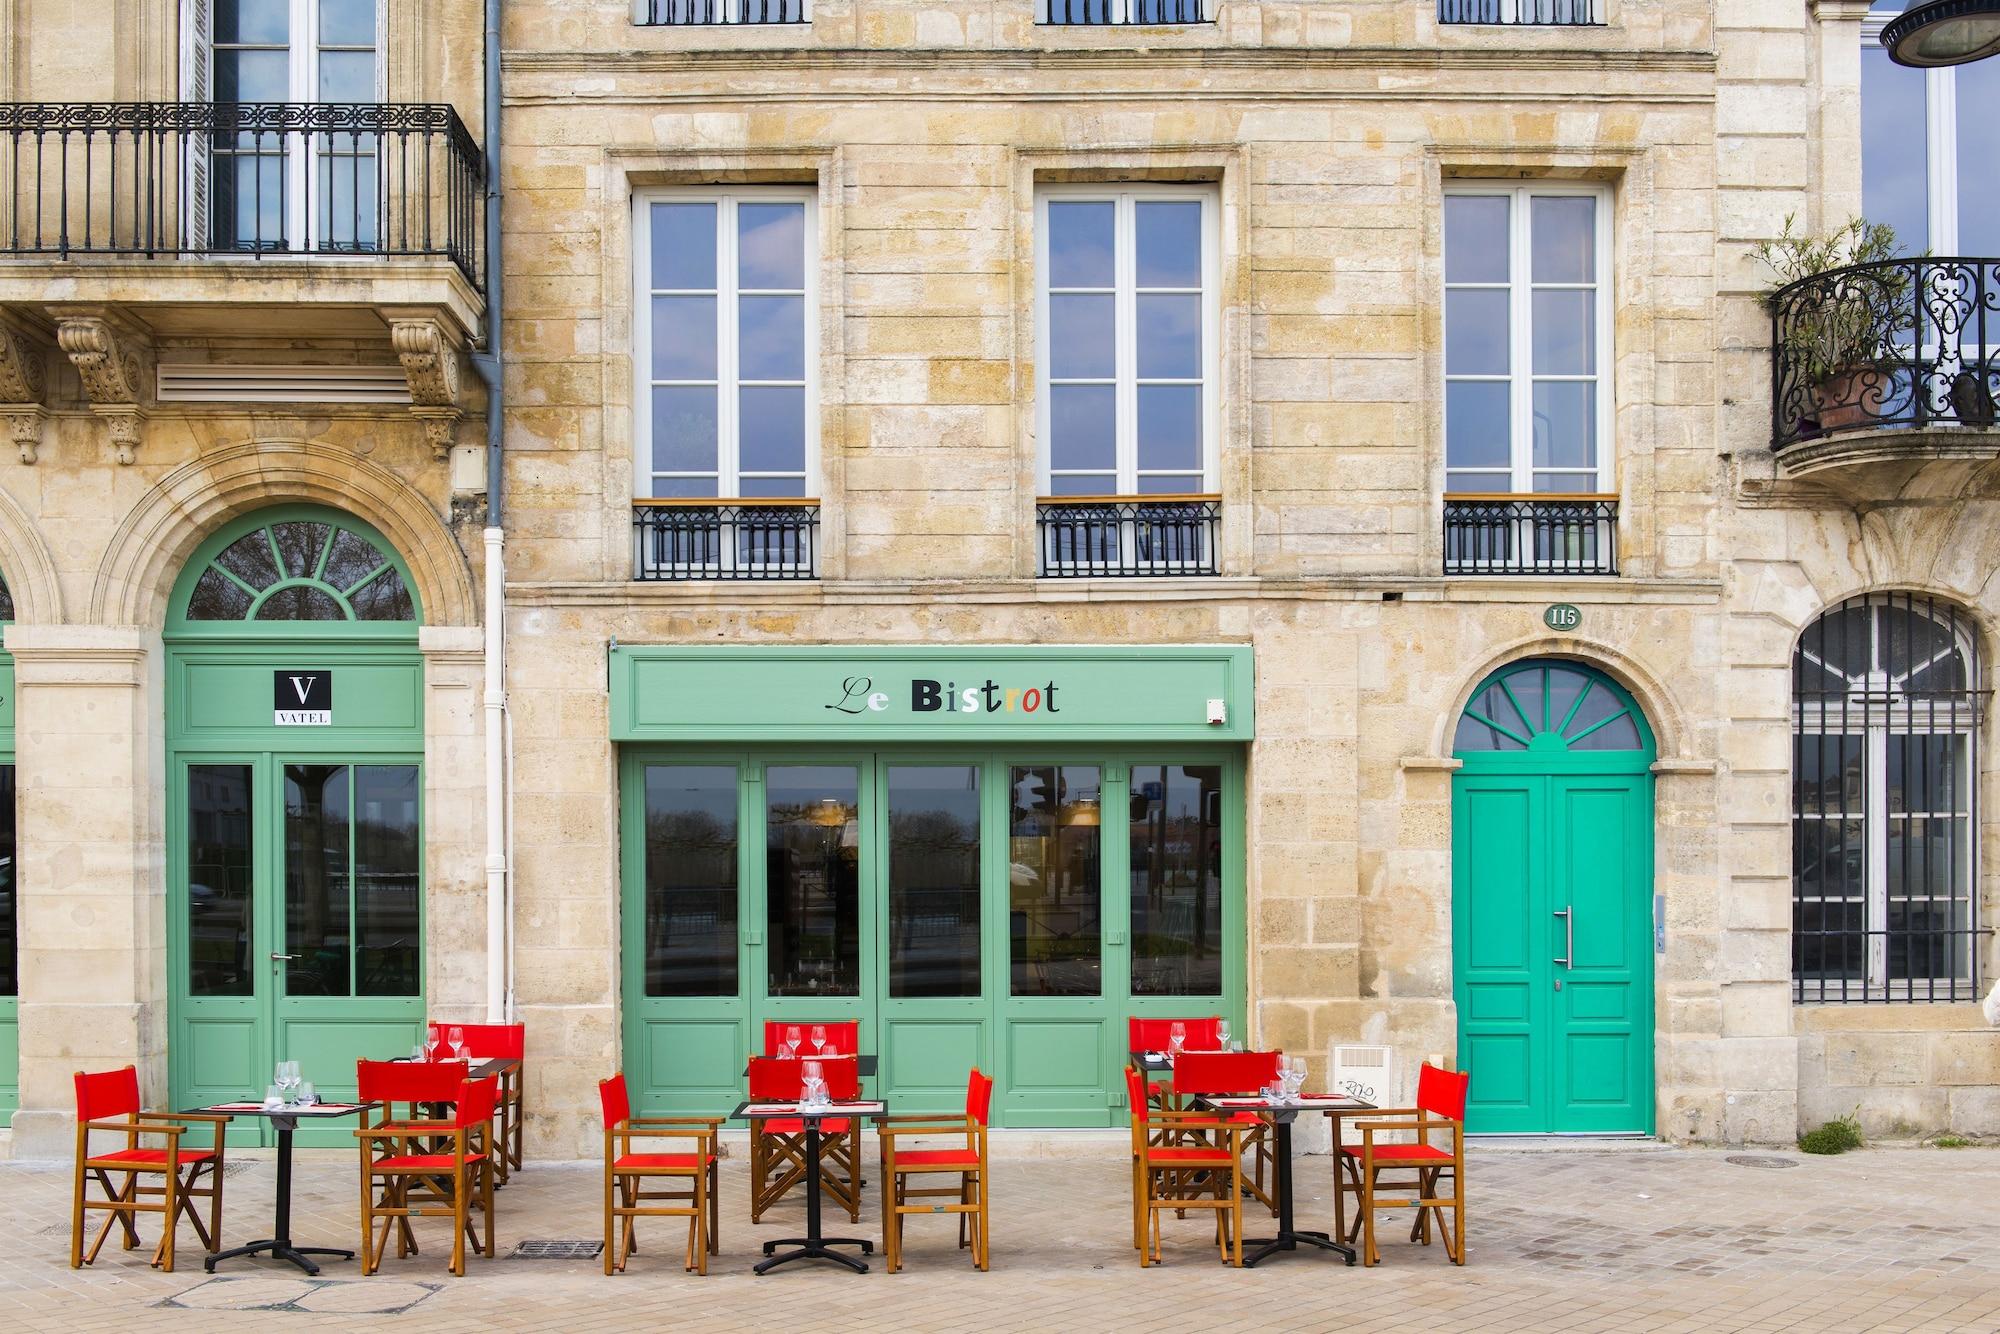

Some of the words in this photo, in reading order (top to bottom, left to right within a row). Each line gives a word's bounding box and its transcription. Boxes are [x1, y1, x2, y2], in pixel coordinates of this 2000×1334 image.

[1551, 609, 1576, 625] 115
[288, 676, 317, 705] V
[824, 676, 889, 714] Le
[911, 679, 1060, 713] Bistrot
[280, 713, 328, 723] VATEL
